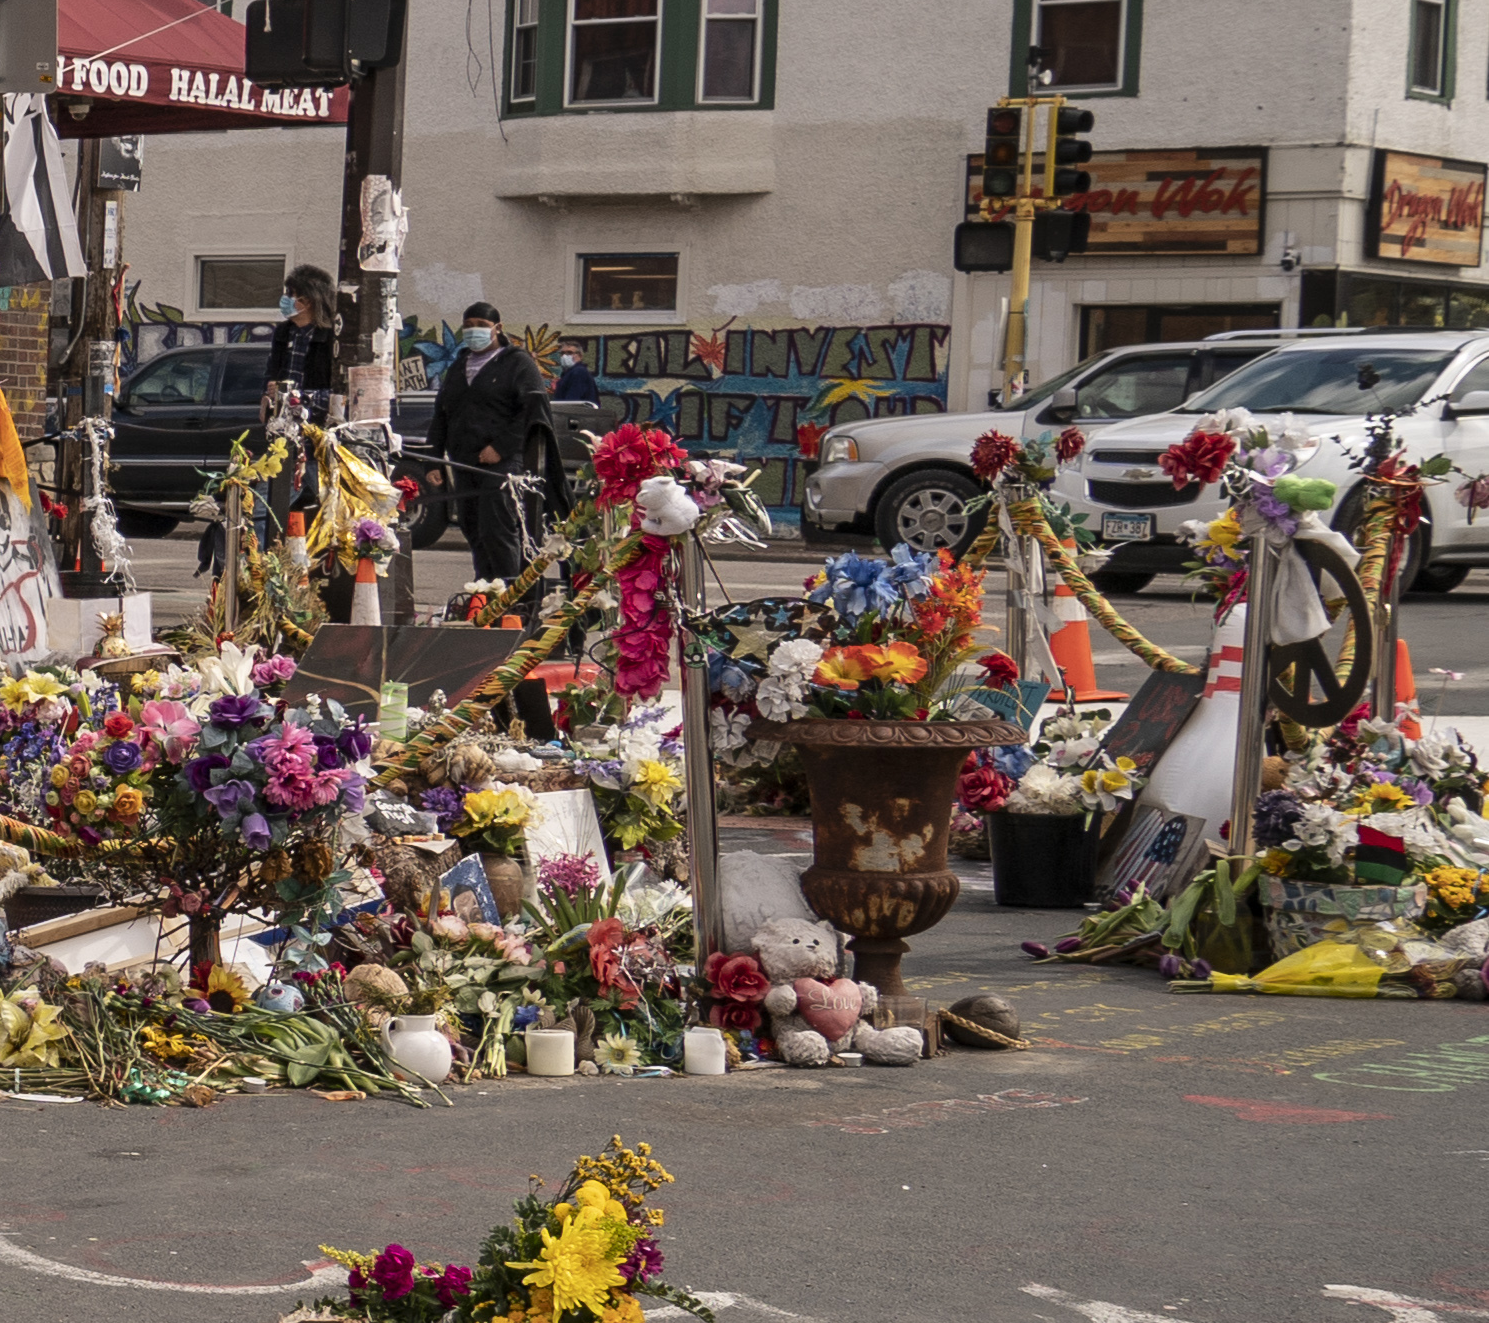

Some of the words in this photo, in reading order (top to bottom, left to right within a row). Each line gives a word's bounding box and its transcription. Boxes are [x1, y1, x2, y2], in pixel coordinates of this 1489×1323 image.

[71, 58, 148, 97] FOOD
[169, 68, 255, 111] HALAL
[260, 87, 333, 117] MEAT
[1146, 167, 1258, 220] Wok
[1444, 180, 1484, 229] Wok
[723, 324, 951, 380] INVEST
[399, 373, 428, 392] ATH
[807, 987, 858, 1010] Love
